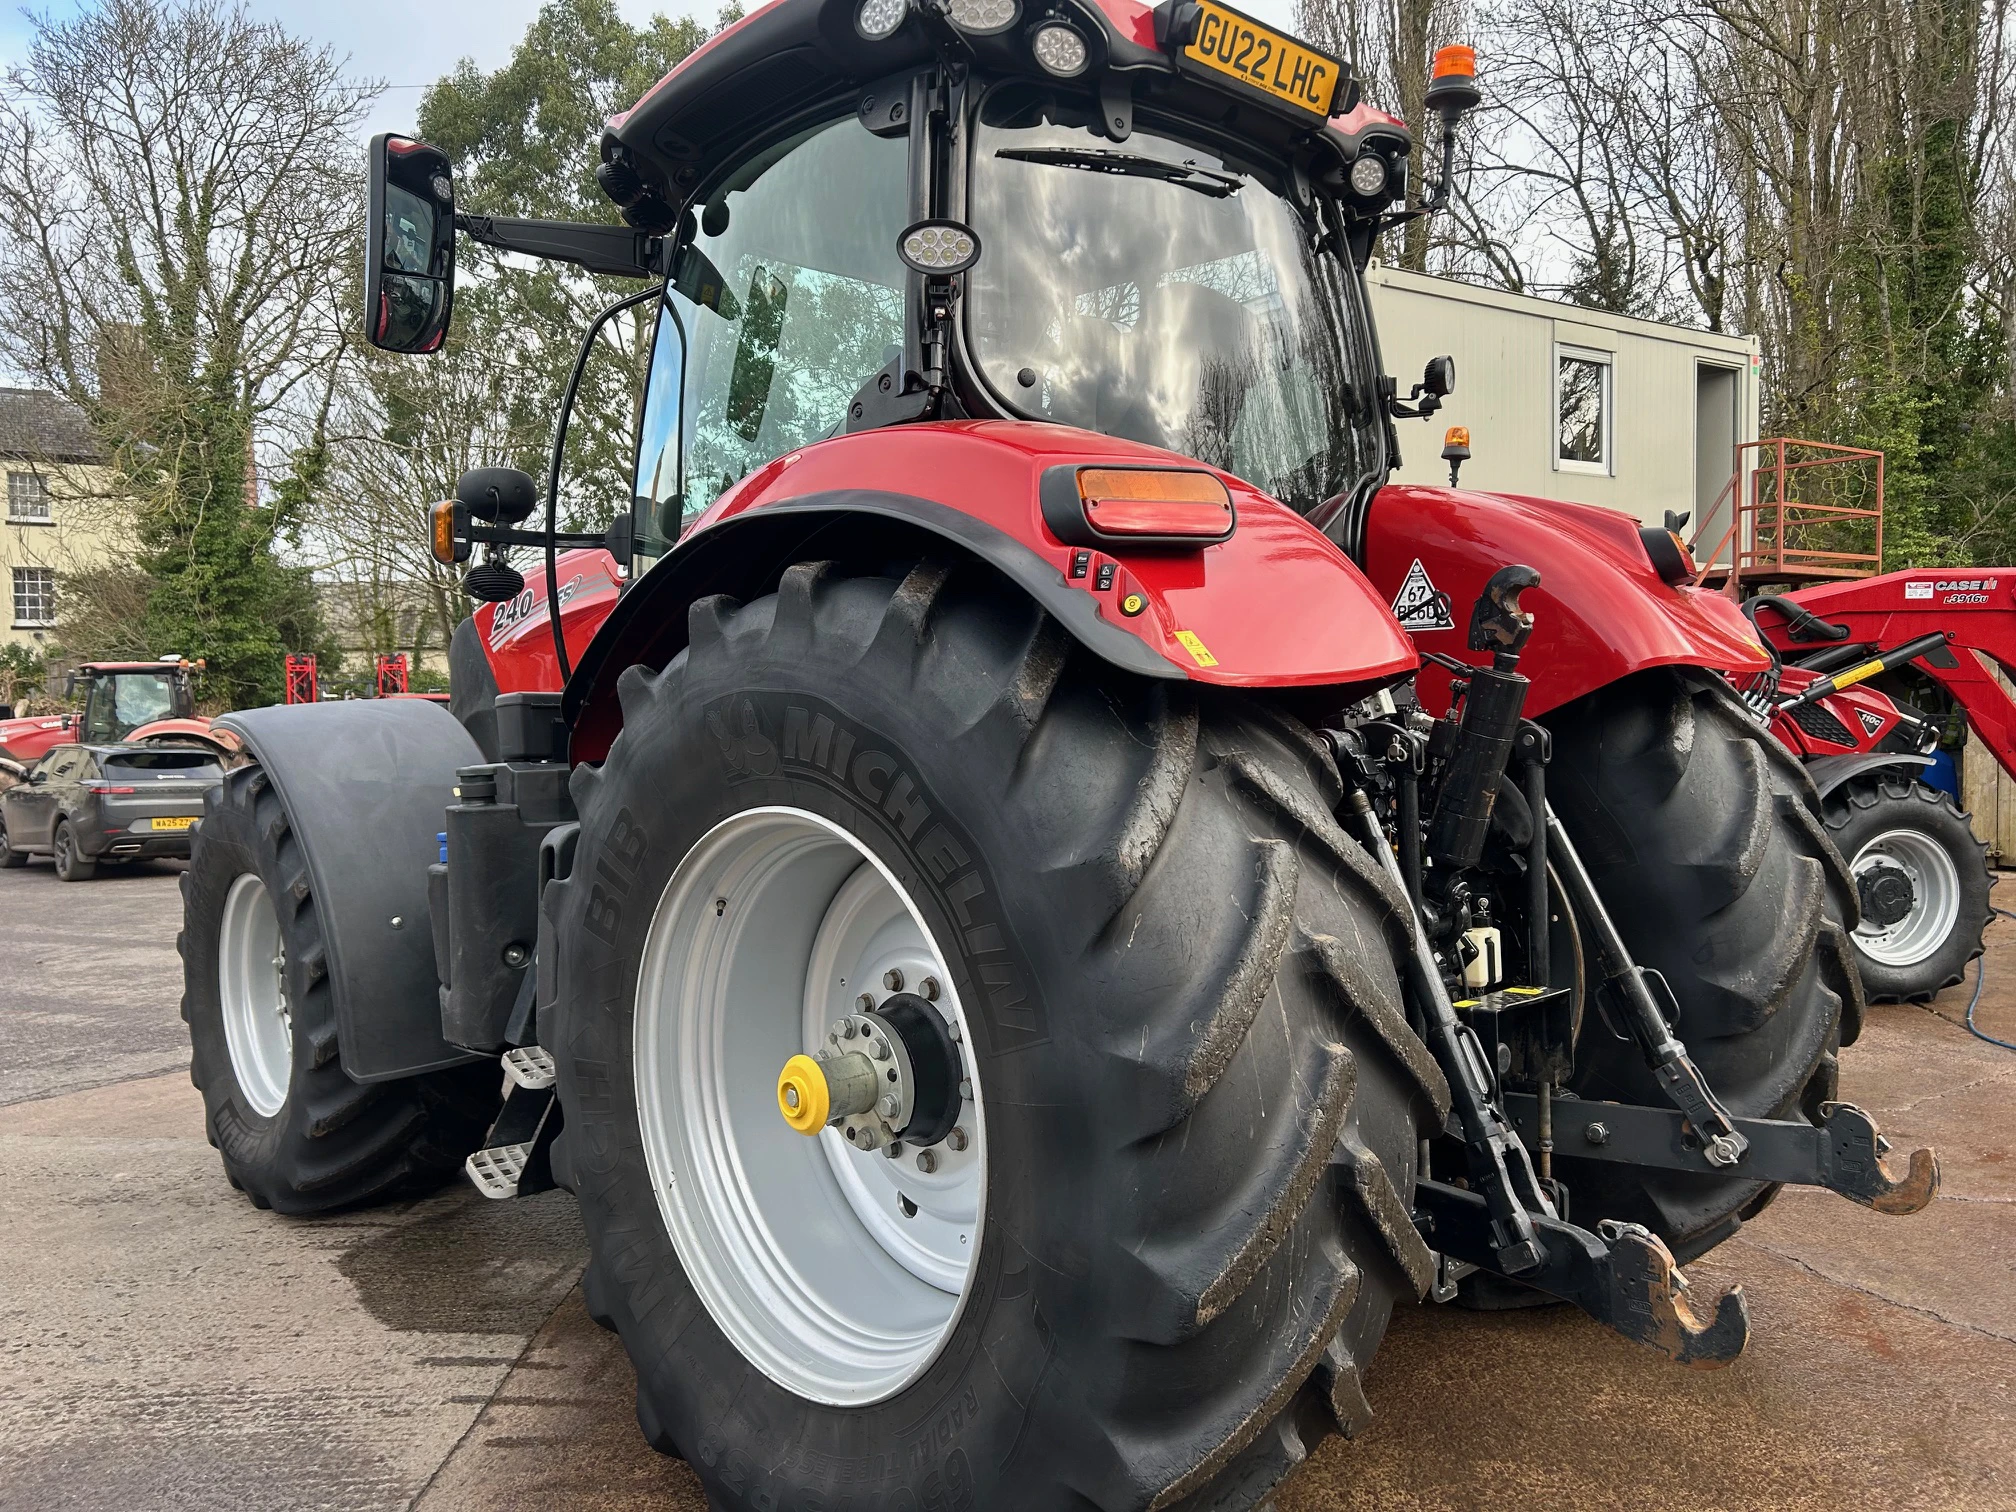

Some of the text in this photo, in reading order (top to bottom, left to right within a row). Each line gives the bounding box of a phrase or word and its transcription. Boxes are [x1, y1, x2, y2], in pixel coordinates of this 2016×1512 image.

[1199, 13, 1326, 104] GU22 LHC
[1408, 586, 1426, 602] 67
[1935, 580, 1981, 591] CASE
[492, 588, 534, 634] 240
[782, 705, 1037, 1033] MICHELIN
[908, 1384, 981, 1470] RADIAL
[783, 1444, 901, 1484] TUBELESS
